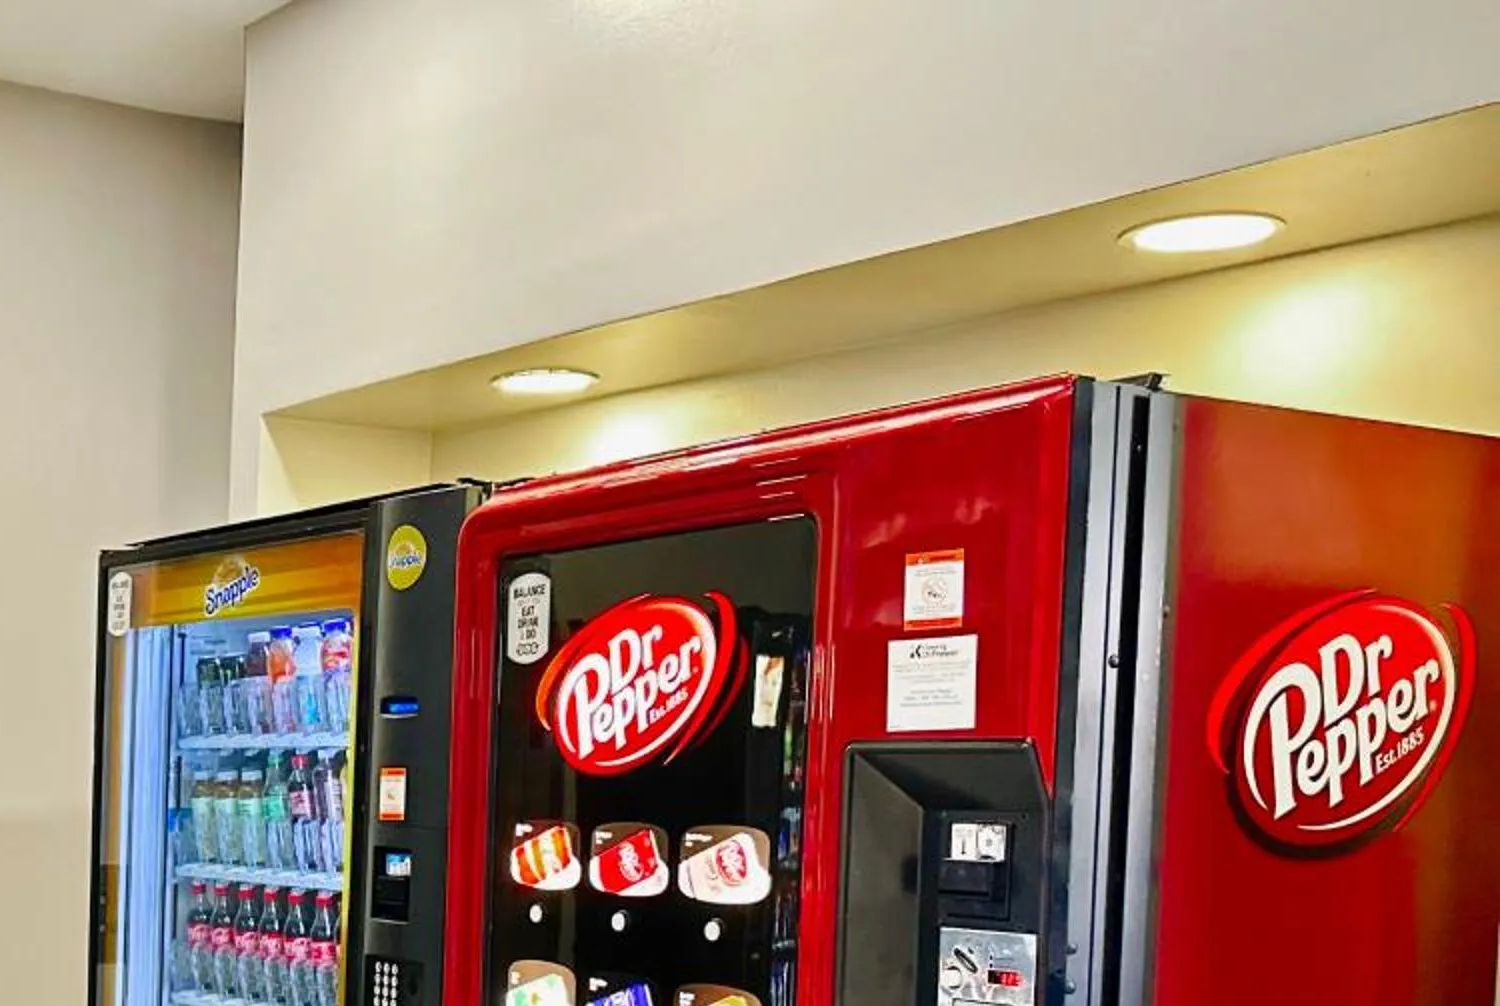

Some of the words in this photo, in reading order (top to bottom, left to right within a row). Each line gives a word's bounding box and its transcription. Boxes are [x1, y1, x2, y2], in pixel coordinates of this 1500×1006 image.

[206, 566, 258, 614] Snapple
[558, 635, 701, 760] Pepper
[608, 625, 663, 693] Dr
[1318, 634, 1393, 728] Dr
[1244, 659, 1439, 820] Pepper
